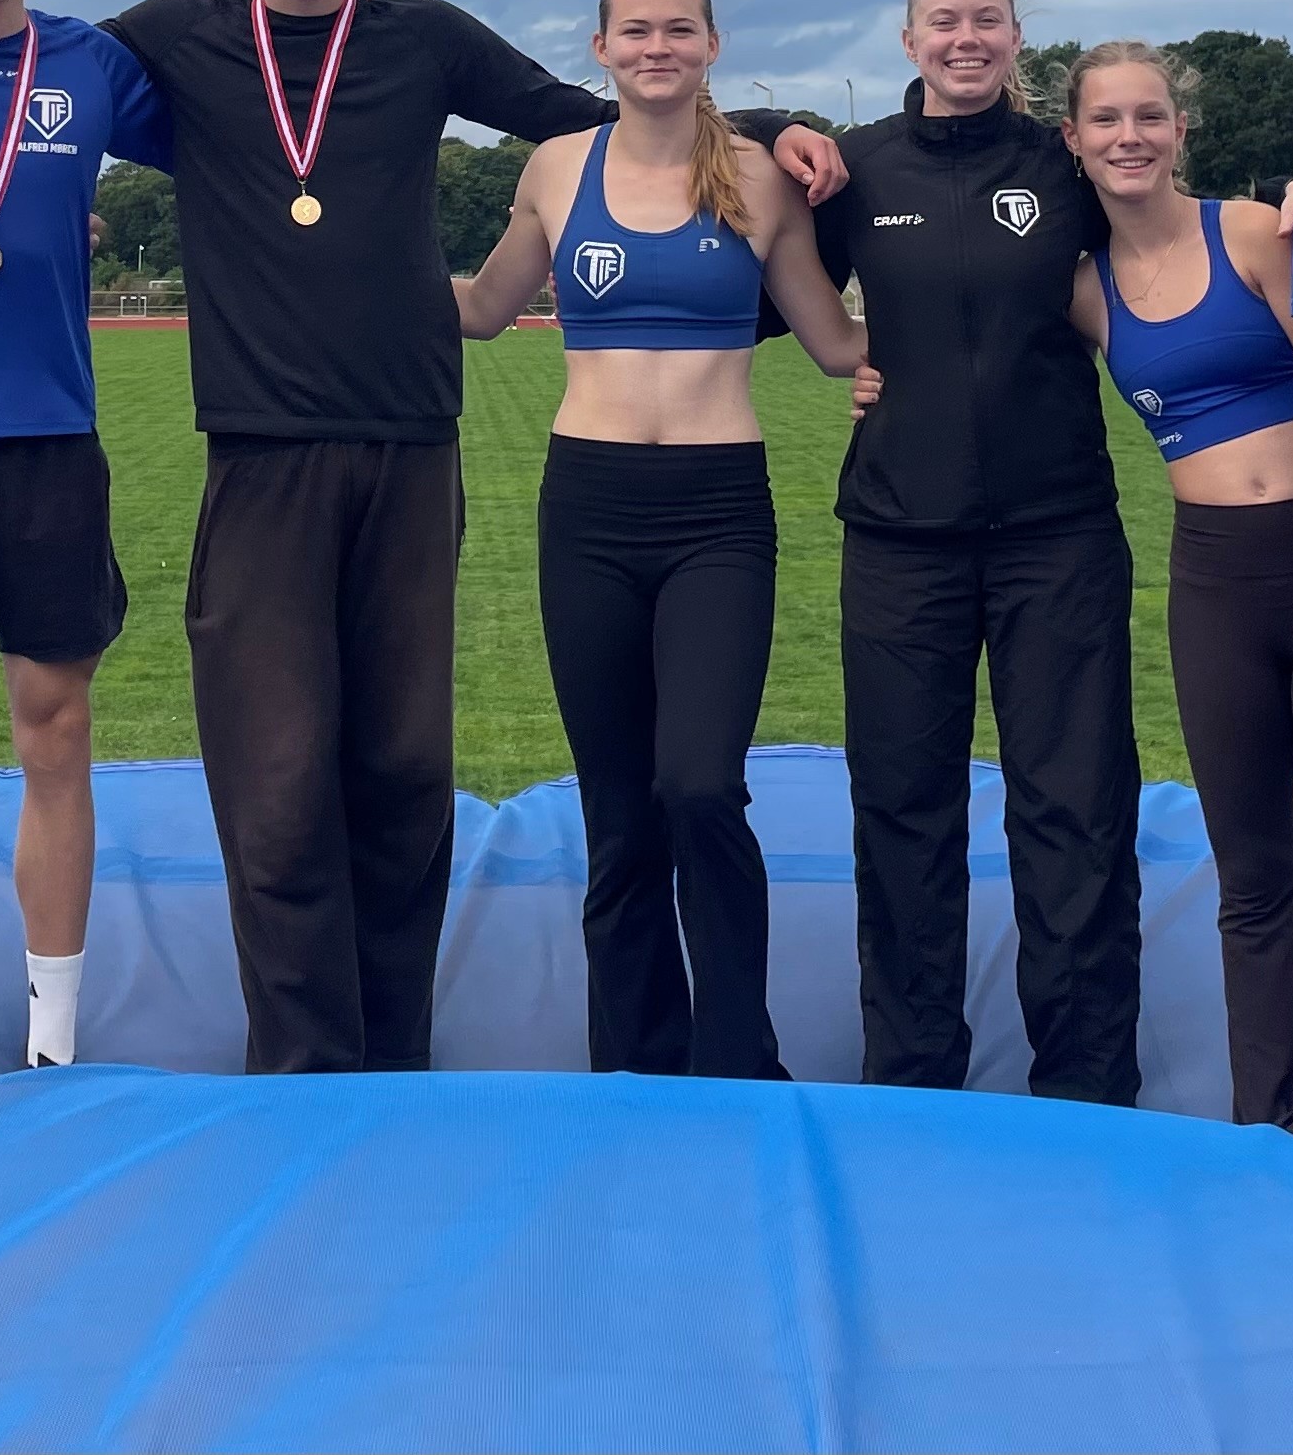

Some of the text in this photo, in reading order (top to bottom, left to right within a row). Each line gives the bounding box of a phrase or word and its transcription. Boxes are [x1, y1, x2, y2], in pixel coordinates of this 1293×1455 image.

[32, 94, 67, 130] TIF
[873, 214, 914, 227] CRAFT
[998, 195, 1034, 228] TIF
[581, 248, 618, 289] TIF
